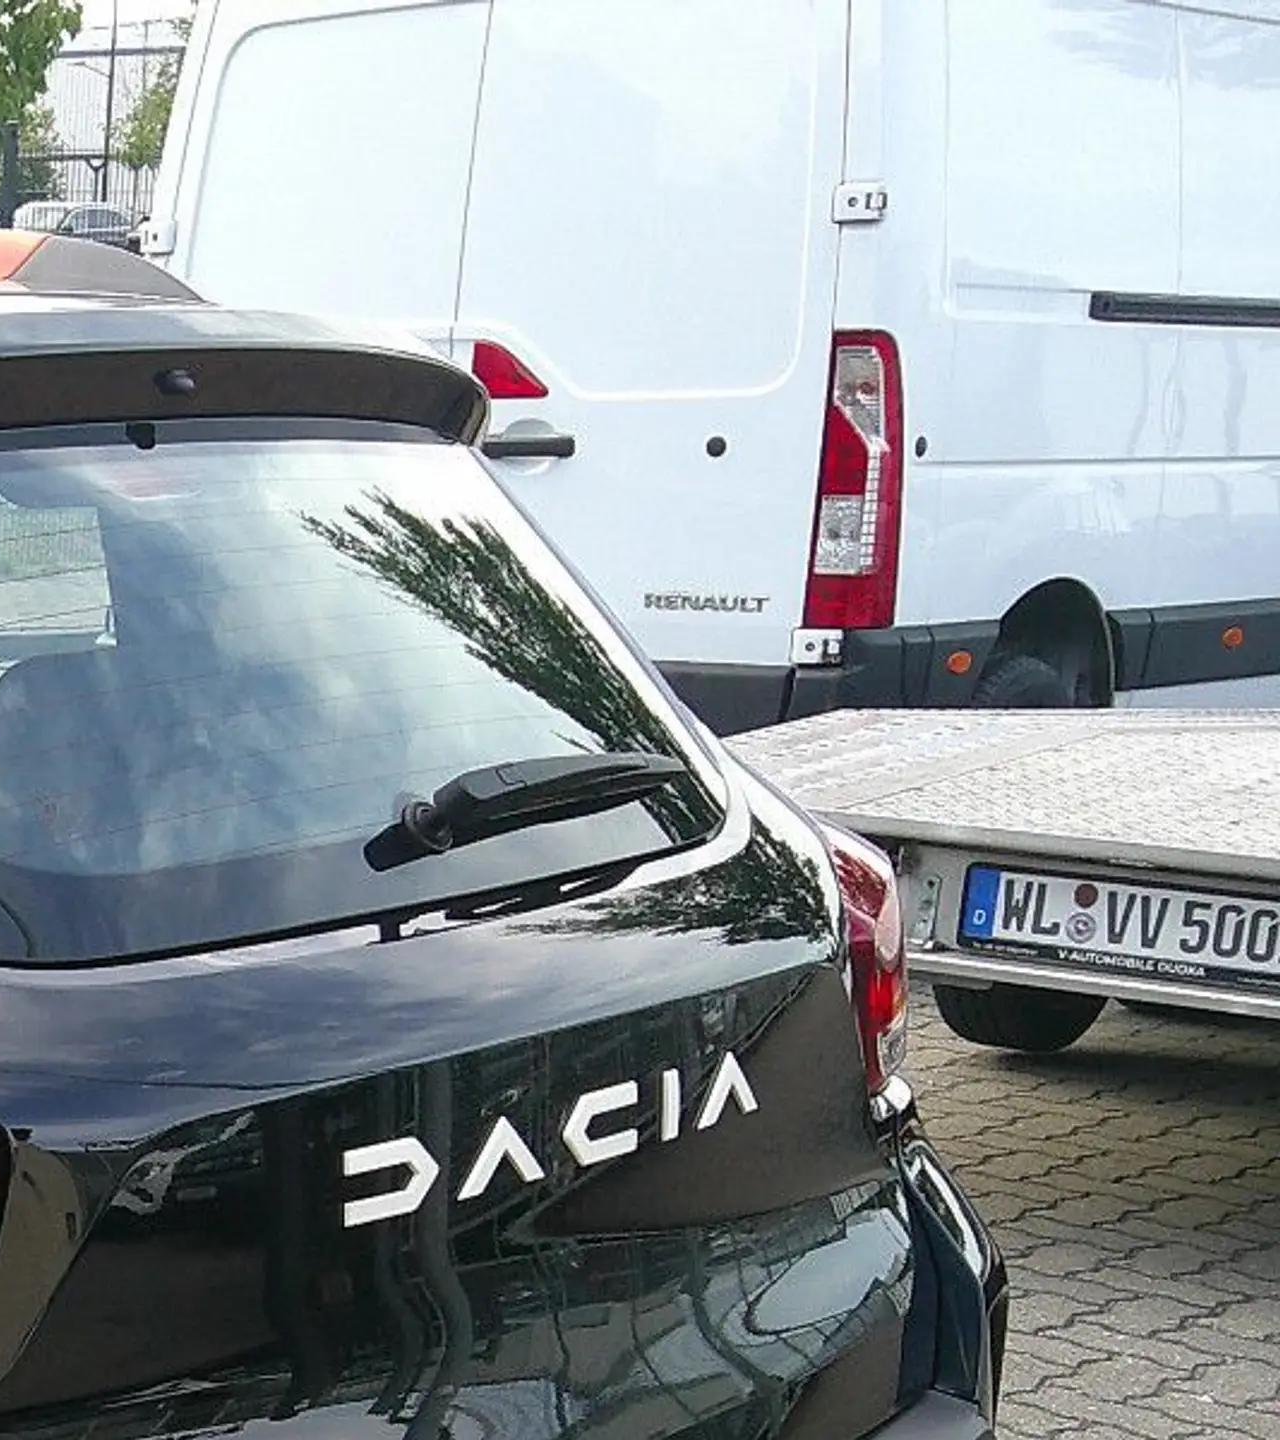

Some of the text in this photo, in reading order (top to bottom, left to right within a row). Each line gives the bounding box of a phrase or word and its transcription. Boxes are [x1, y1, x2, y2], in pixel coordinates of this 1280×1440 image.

[644, 593, 770, 613] RENAULT
[973, 910, 987, 925] D
[1002, 879, 1060, 936] WL
[1107, 890, 1170, 949] VV
[342, 1050, 759, 1228] DACIA
